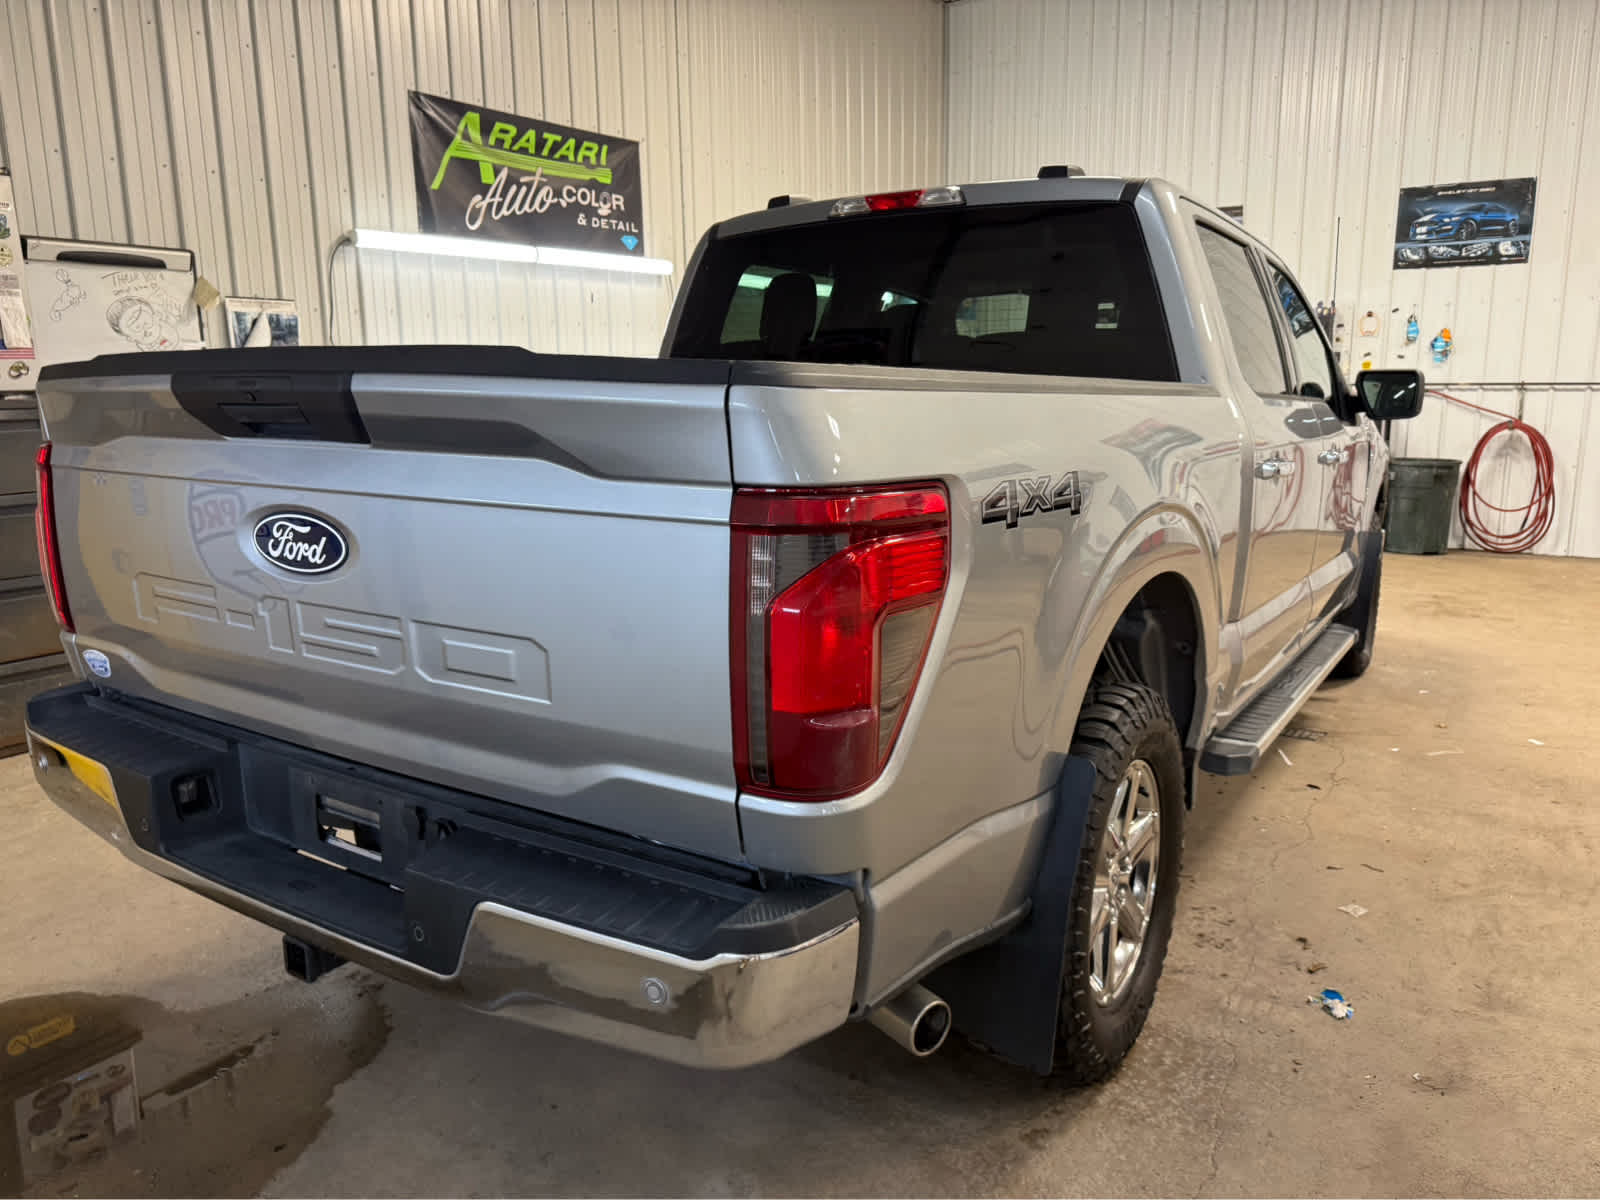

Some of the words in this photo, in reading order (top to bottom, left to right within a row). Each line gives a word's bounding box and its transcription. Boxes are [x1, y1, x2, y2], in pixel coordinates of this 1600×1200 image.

[431, 111, 609, 190] ARATARI
[465, 166, 558, 231] Auto
[562, 185, 625, 214] COLOR
[577, 213, 588, 226] &
[591, 216, 639, 233] DETAIL
[267, 520, 327, 565] Ford
[133, 571, 552, 705] F-150
